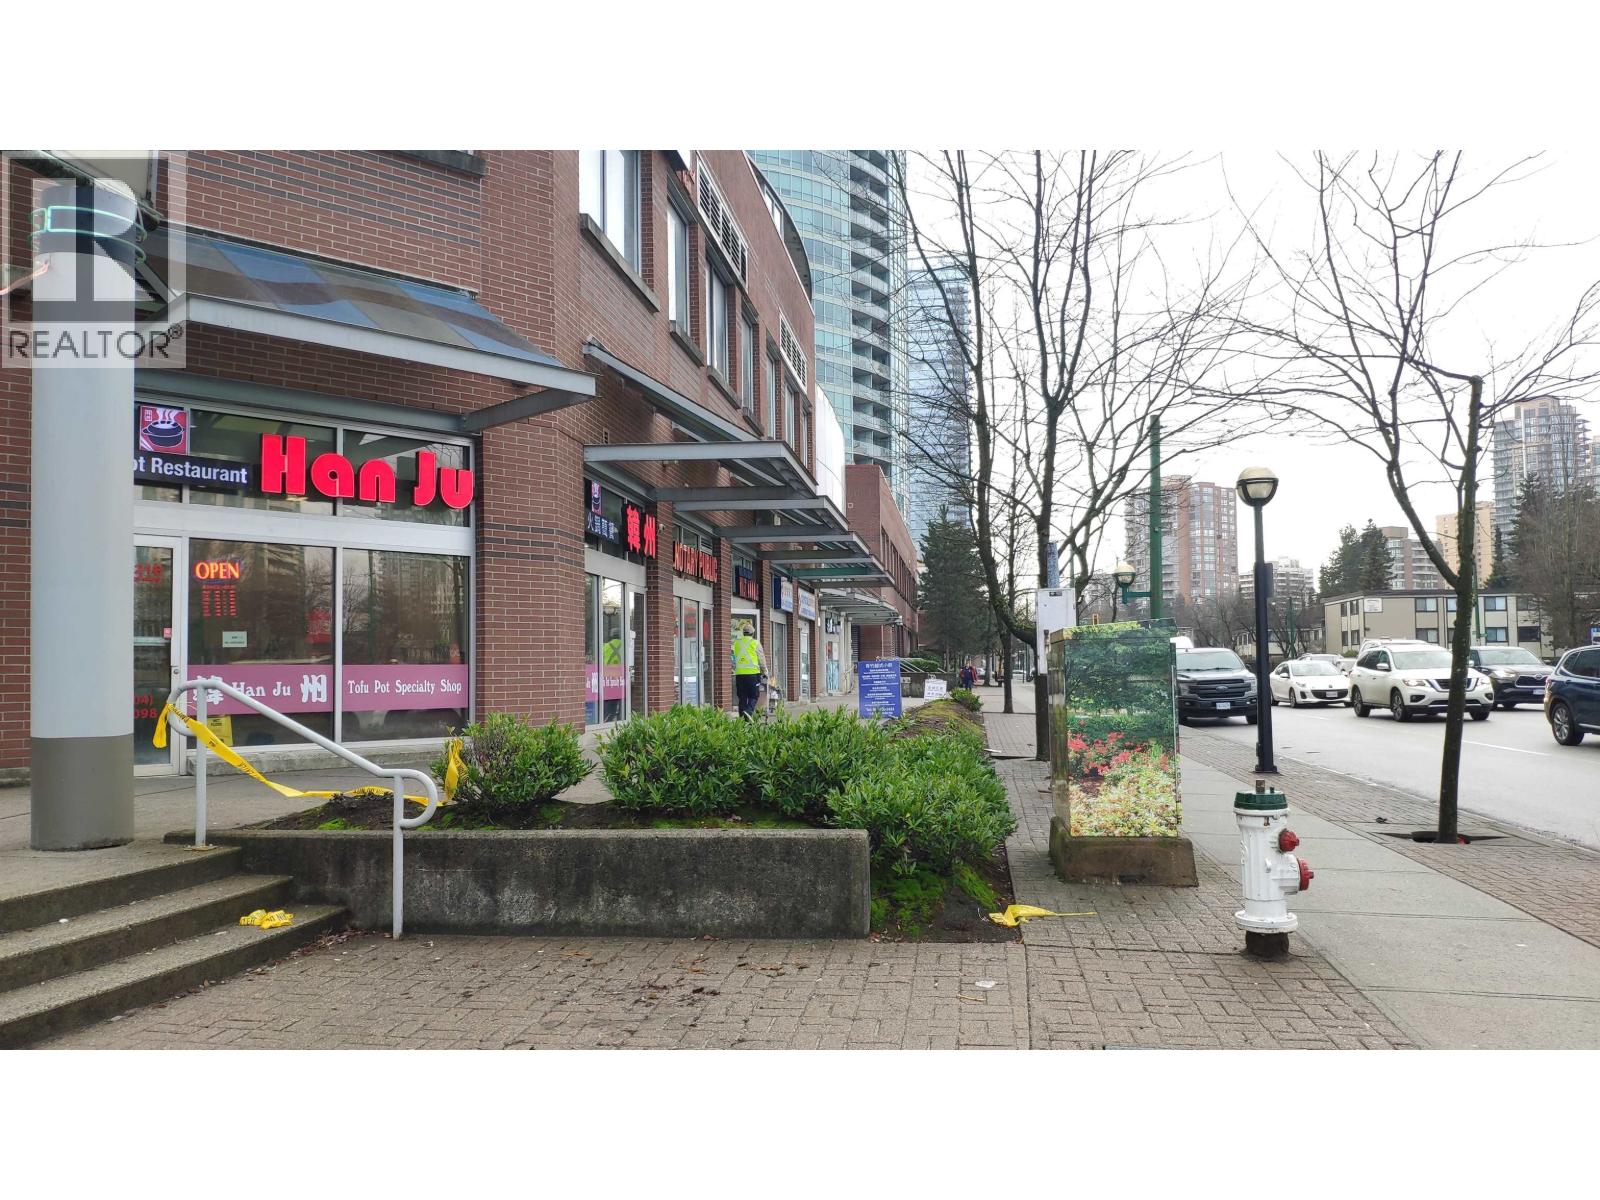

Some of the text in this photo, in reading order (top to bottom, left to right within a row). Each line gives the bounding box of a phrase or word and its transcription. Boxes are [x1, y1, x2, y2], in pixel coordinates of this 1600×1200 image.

[151, 457, 248, 484] Restaurant
[262, 433, 474, 510] Han Ju
[195, 562, 240, 580] OPEN
[673, 541, 718, 584] NOTARY PUBLIC
[231, 681, 266, 697] Han
[272, 681, 291, 697] Ju
[347, 679, 462, 696] Tofu Pot Specialty Shop
